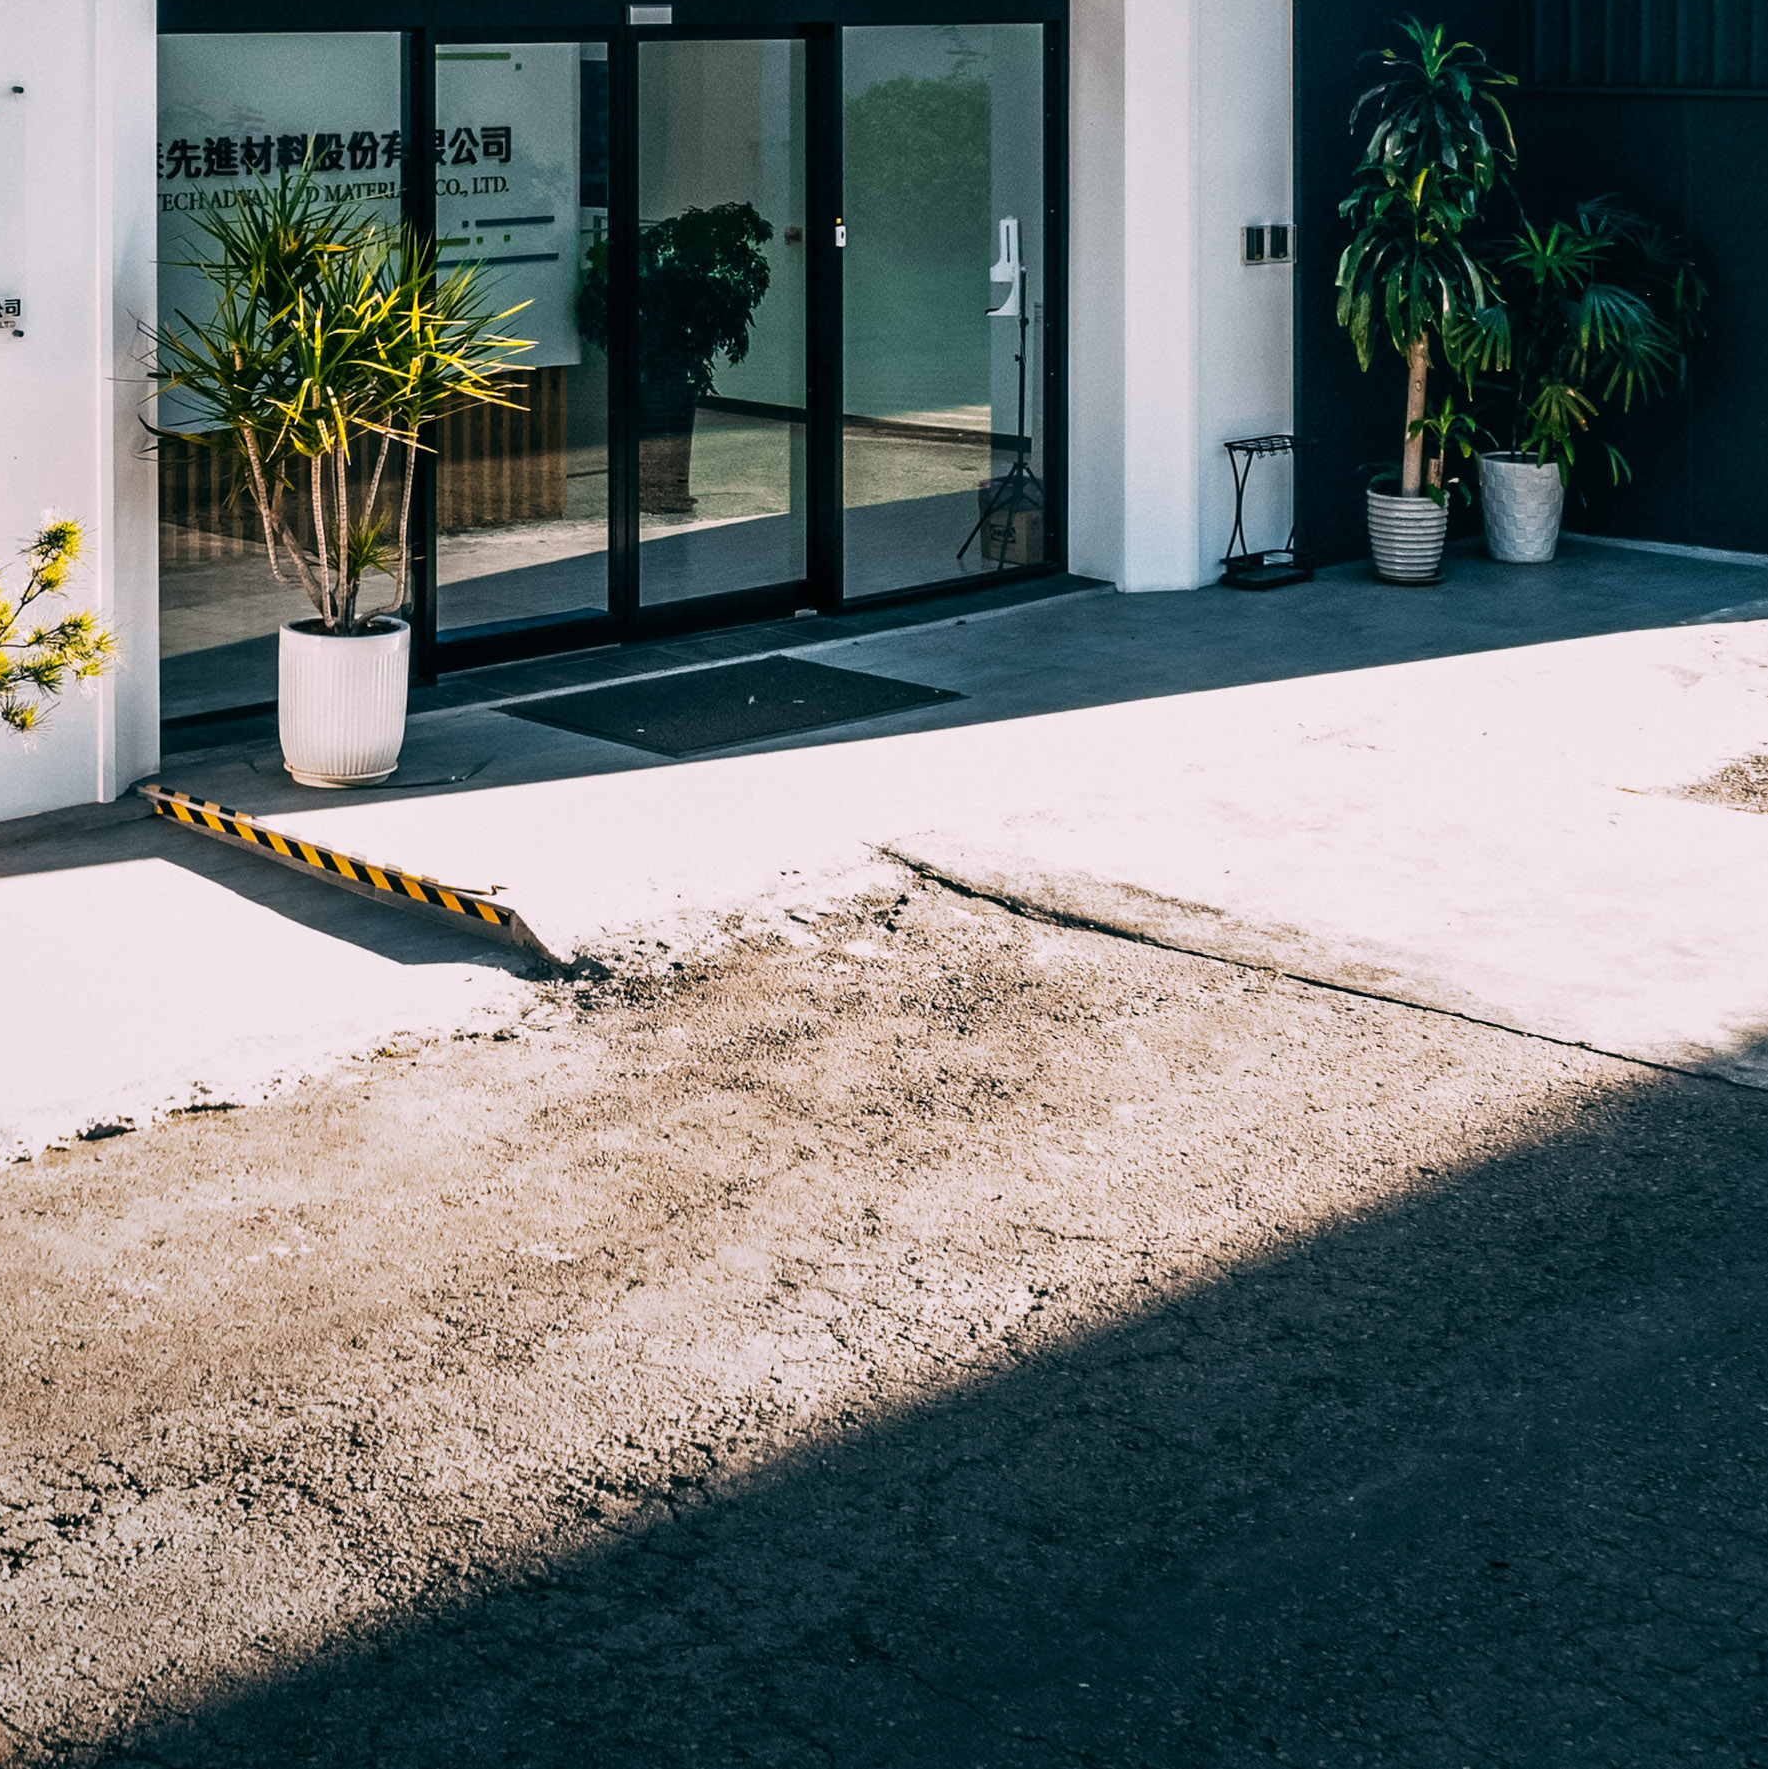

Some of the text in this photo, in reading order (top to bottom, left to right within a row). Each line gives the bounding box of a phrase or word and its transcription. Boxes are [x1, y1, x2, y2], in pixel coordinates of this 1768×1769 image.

[157, 126, 512, 180] 先進材料股份有公司
[157, 190, 205, 212] ECH
[472, 175, 510, 195] LTD.
